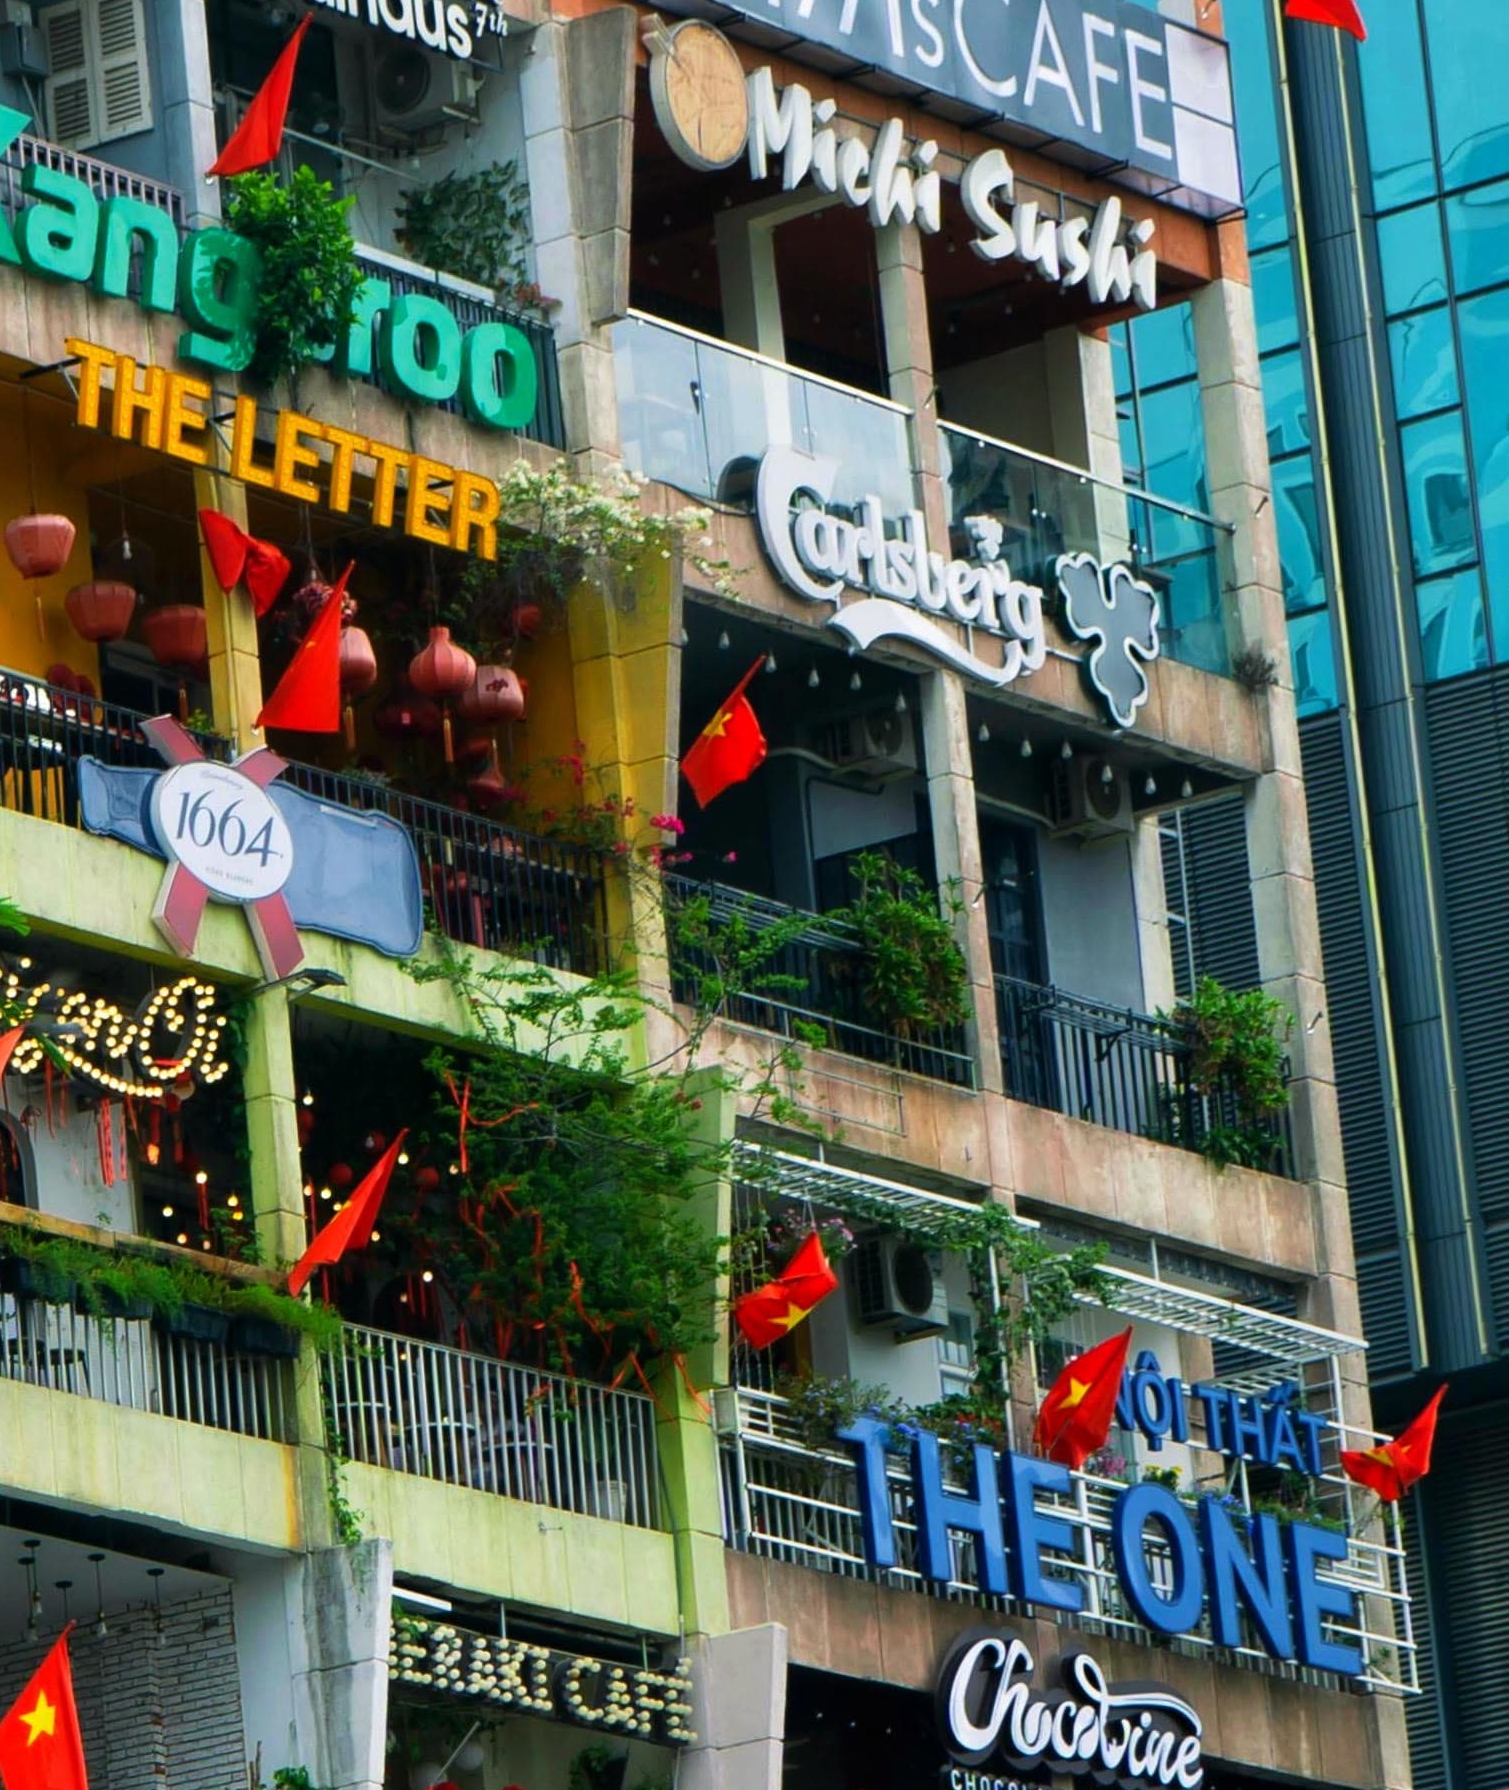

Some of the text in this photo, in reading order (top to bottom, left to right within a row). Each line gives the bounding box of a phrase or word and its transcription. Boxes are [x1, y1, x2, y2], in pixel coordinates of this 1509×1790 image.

[474, 1, 509, 38] 7th
[746, 65, 1158, 311] Michi Sushi
[64, 337, 502, 562] THE LETTER
[754, 444, 1048, 686] Carlsberg
[176, 789, 277, 868] 1664
[1191, 1378, 1329, 1477] THẤT
[837, 1416, 1366, 1678] THE ONE
